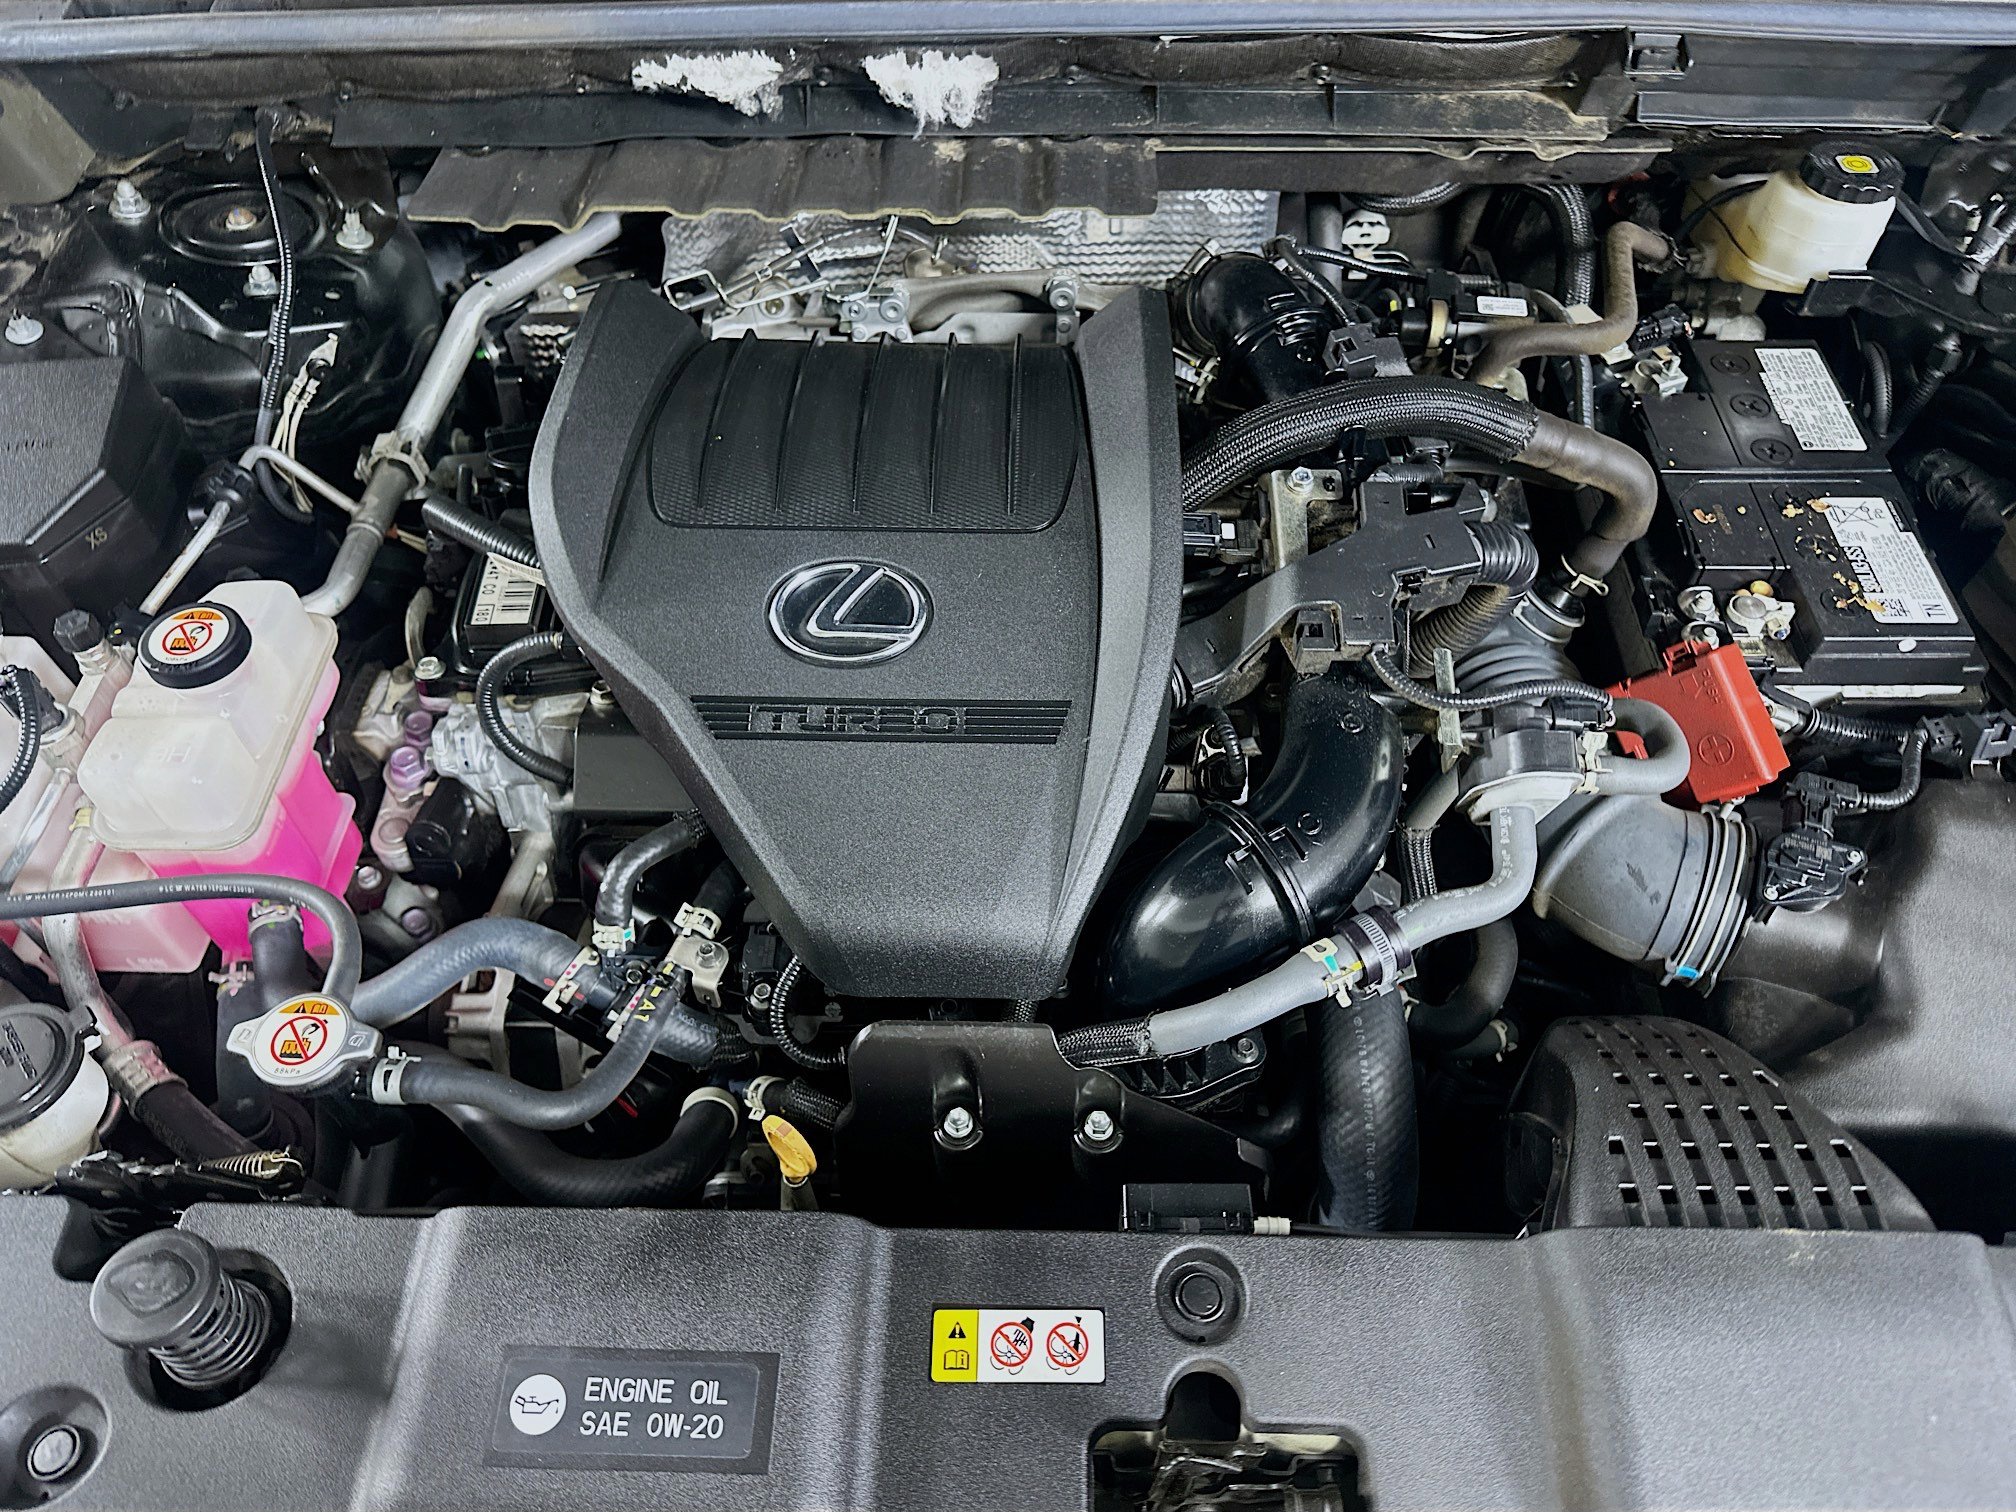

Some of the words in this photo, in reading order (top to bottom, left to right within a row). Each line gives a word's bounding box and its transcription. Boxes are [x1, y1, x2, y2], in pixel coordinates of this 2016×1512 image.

[754, 705, 959, 733] TURBO
[584, 1376, 675, 1404] ENGINE
[690, 1379, 728, 1405] OIL
[579, 1411, 632, 1437] SAE
[647, 1412, 724, 1439] 0W-20
